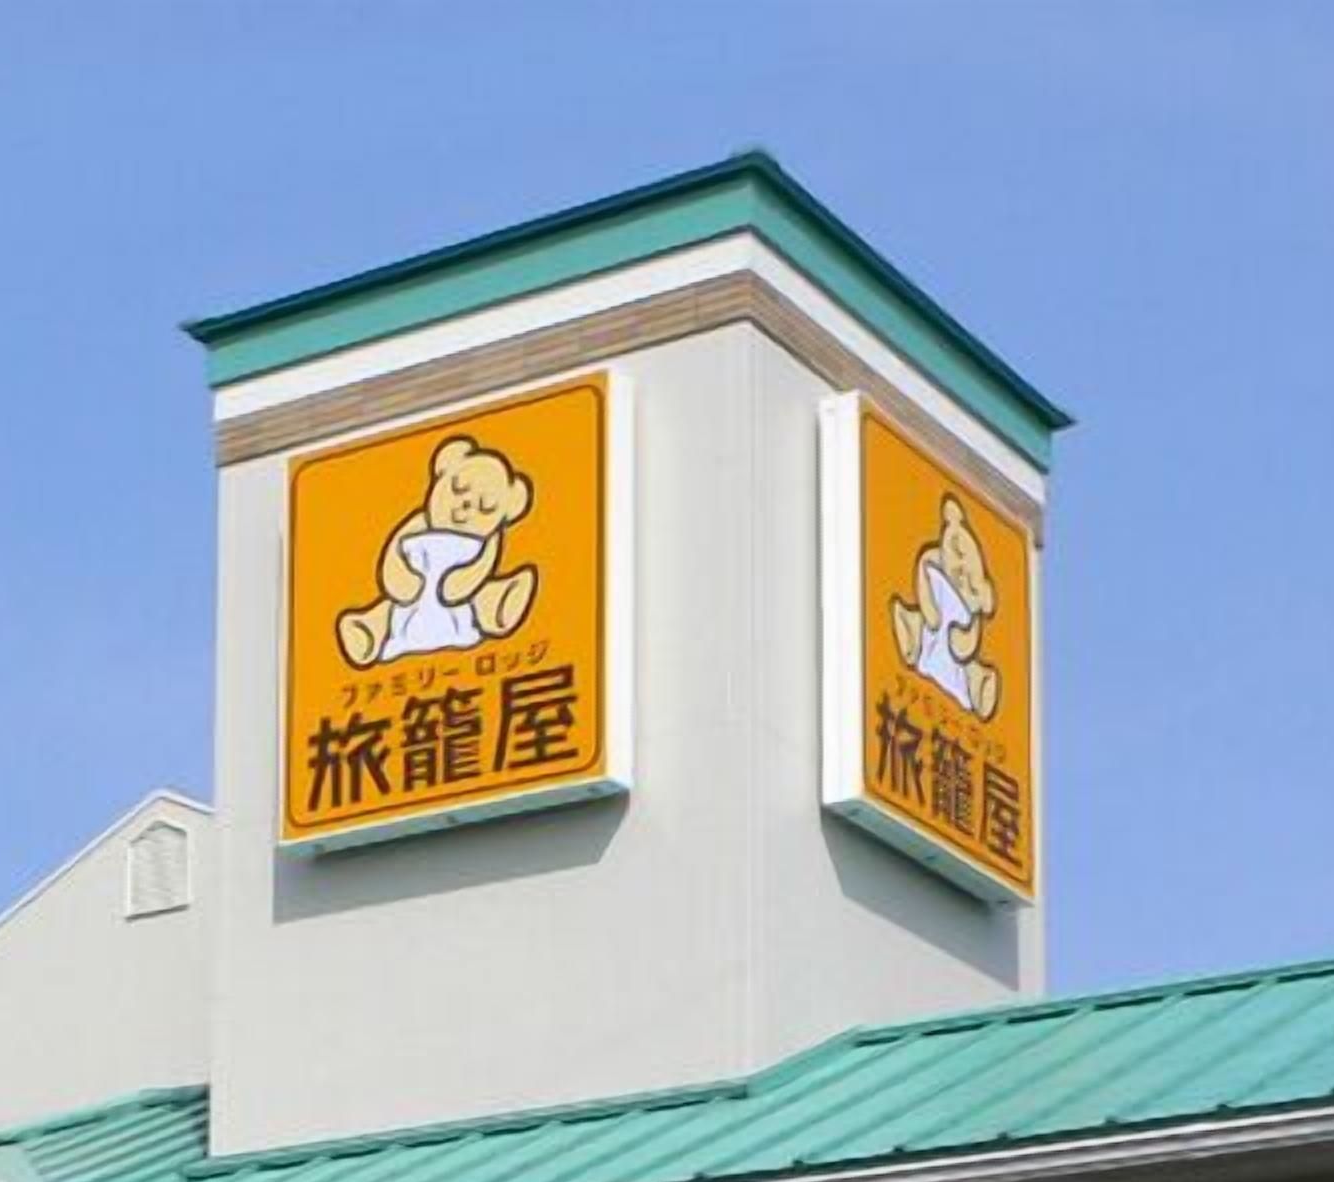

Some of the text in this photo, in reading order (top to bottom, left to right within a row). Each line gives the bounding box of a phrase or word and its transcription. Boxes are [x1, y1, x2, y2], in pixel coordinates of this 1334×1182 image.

[342, 640, 551, 708] ファミリーロッジ
[308, 665, 579, 811] 旅籠屋
